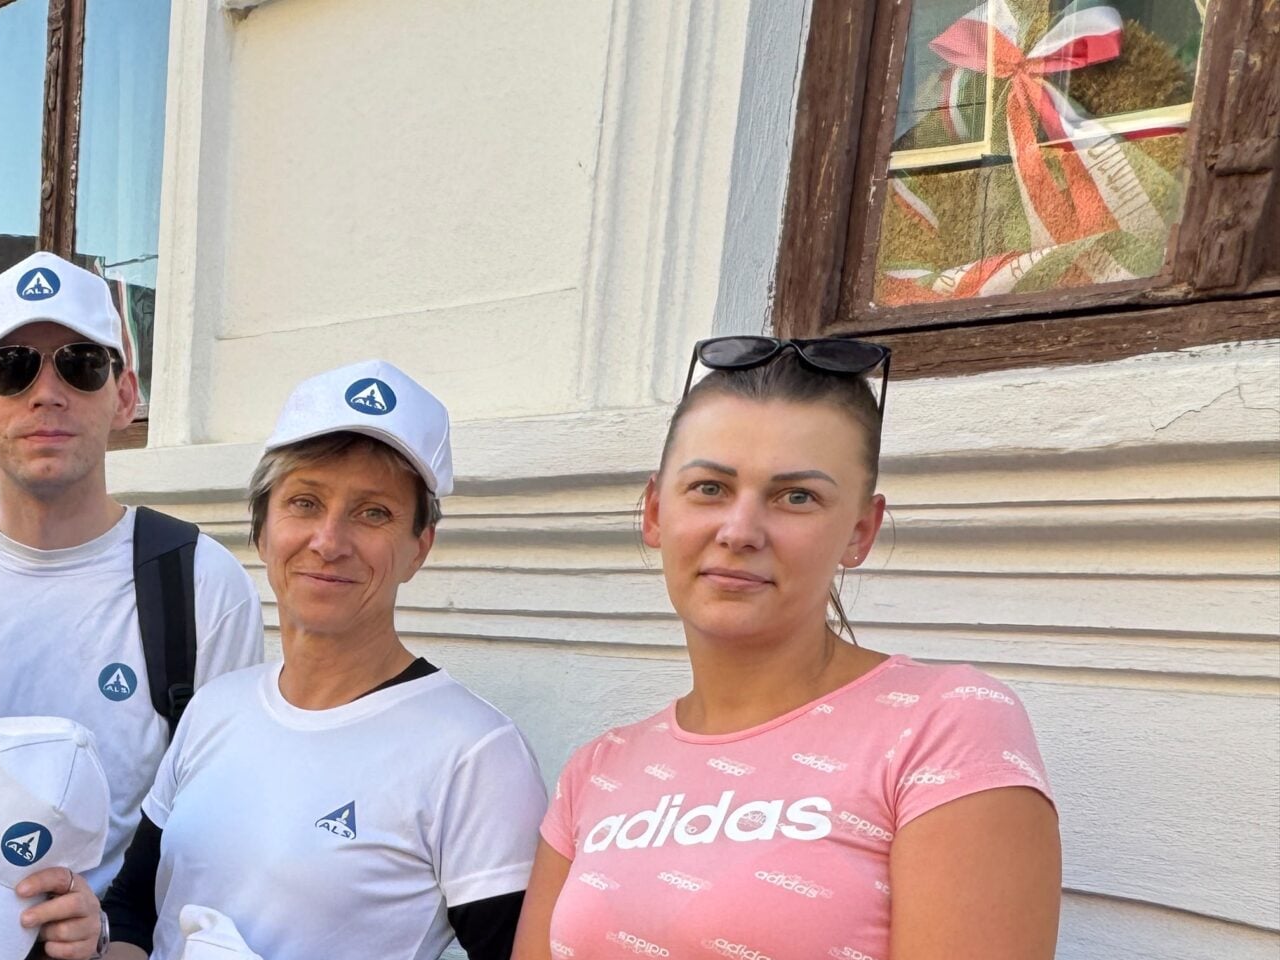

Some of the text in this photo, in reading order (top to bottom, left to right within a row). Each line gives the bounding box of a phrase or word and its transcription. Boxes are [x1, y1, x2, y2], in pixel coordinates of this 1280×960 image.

[582, 790, 833, 854] adidas
[7, 843, 33, 861] ALS
[754, 870, 819, 898] adidas
